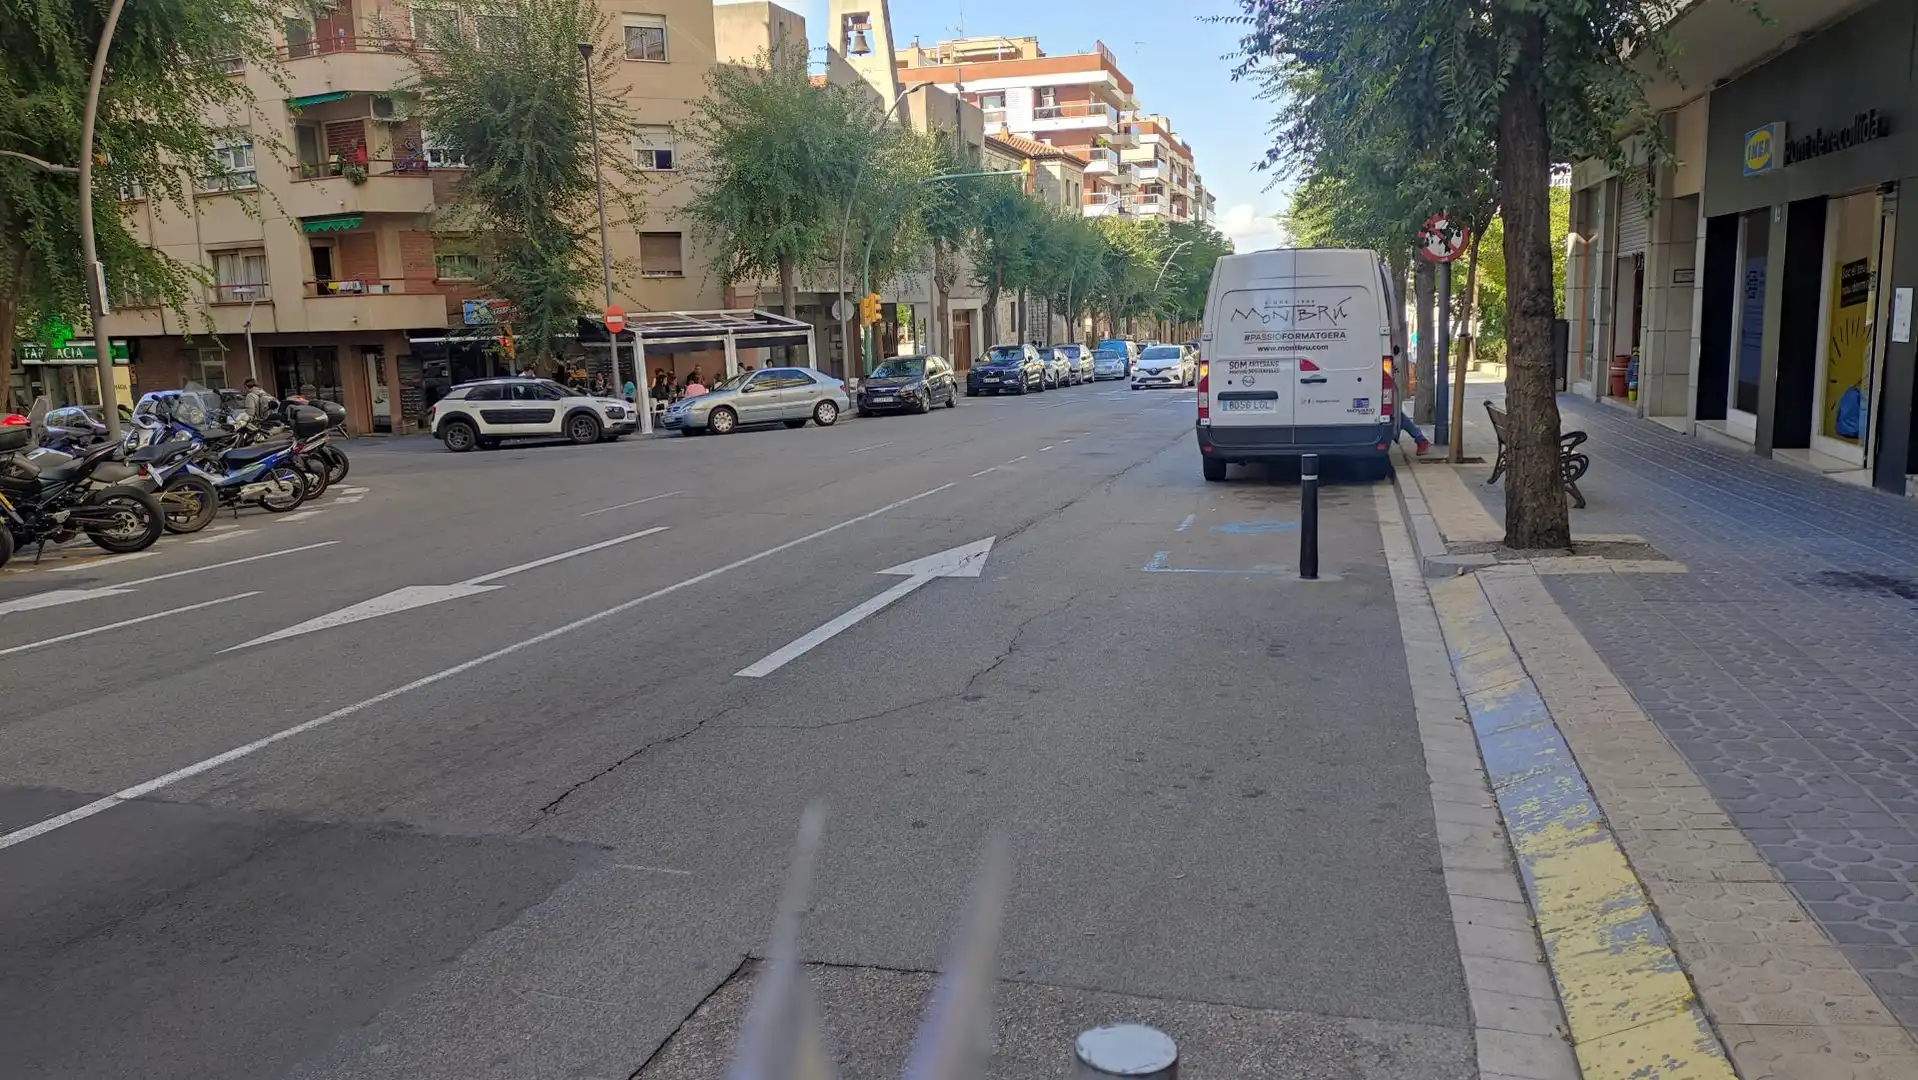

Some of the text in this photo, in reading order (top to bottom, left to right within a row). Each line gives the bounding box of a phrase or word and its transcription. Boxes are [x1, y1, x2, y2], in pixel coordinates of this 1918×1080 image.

[1749, 139, 1772, 160] IKEA
[25, 348, 84, 359] FARACIA
[1229, 361, 1248, 369] SOM
